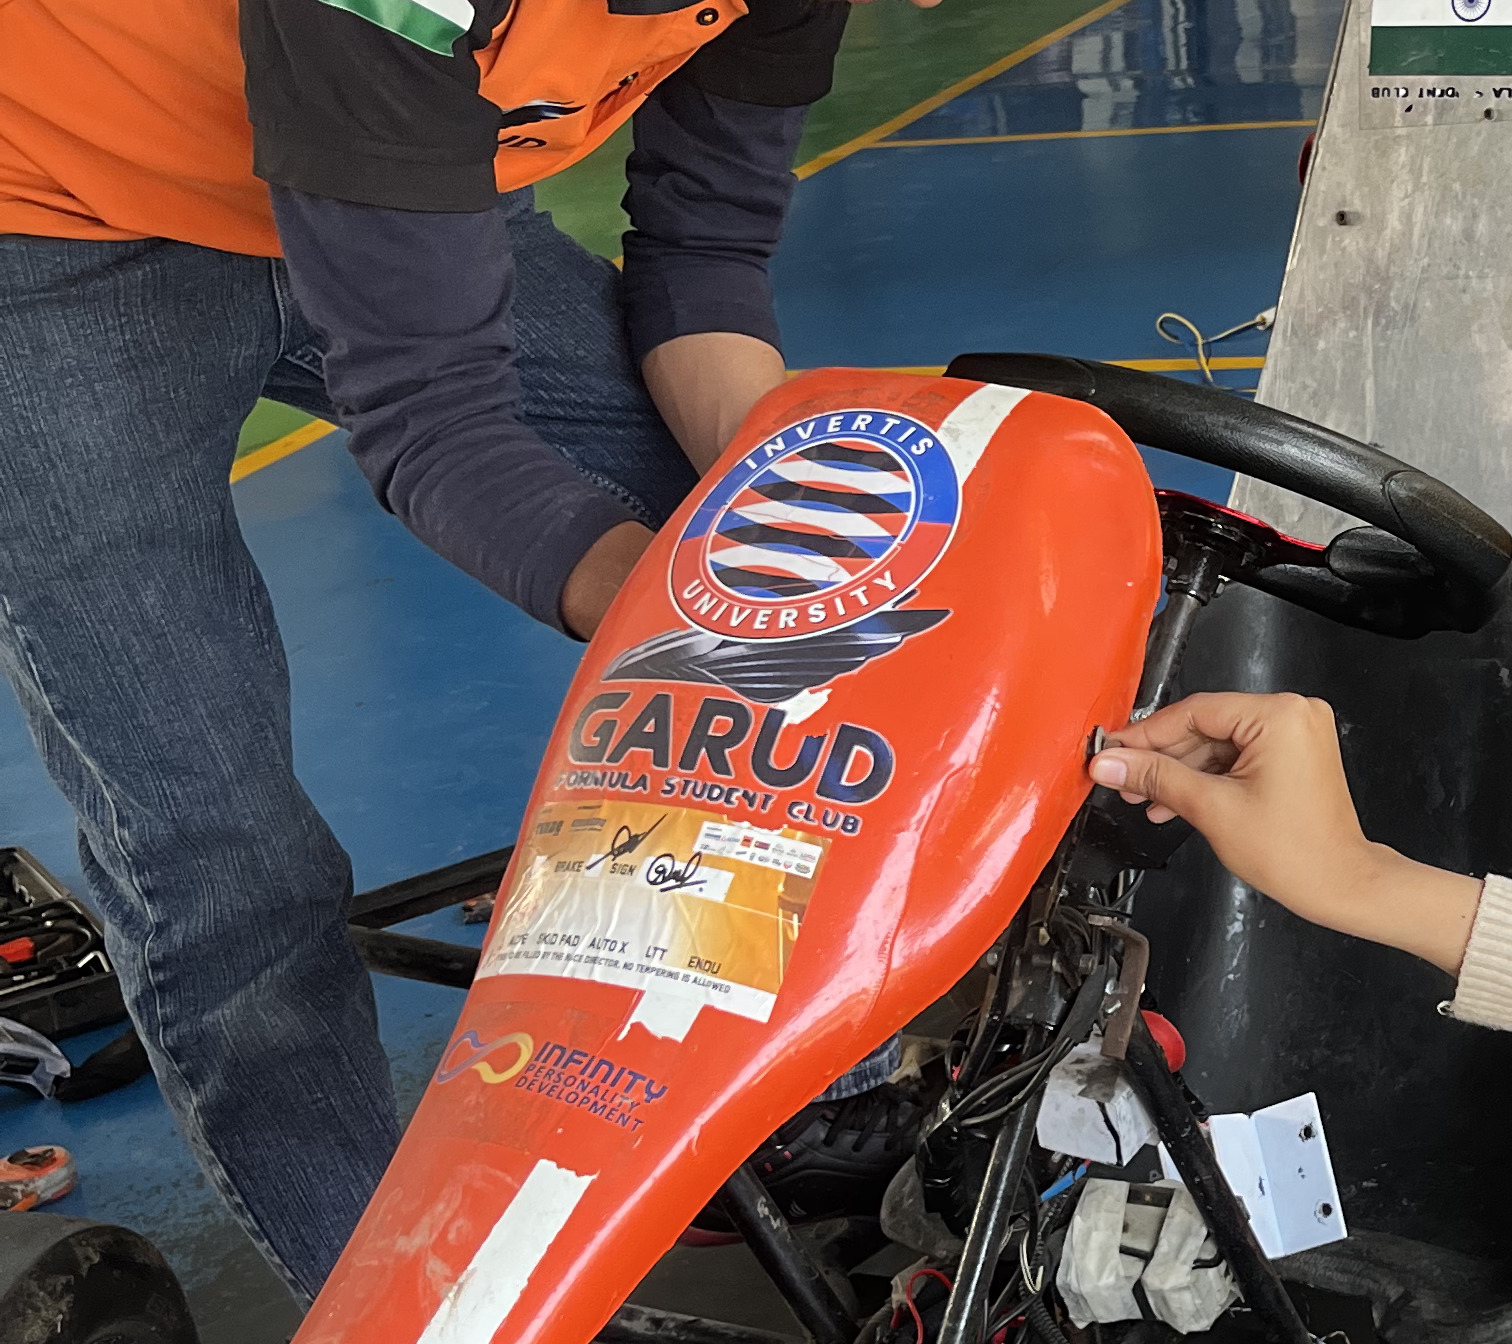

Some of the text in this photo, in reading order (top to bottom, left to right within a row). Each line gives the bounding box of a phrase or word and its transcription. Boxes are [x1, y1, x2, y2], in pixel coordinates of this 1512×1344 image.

[744, 413, 935, 471] INVERTIS
[683, 570, 897, 630] UNIVERSITY
[569, 692, 895, 805] GARUD
[661, 777, 777, 811] STUDENT
[787, 800, 862, 836] CLUB
[609, 862, 637, 876] SIGN
[617, 941, 630, 954] X
[645, 945, 668, 961] LTT
[687, 956, 722, 975] ENDU
[525, 1063, 640, 1112] PERSONALITY
[534, 1041, 668, 1103] INFINITY
[515, 1076, 645, 1133] DEVELOPMENT
